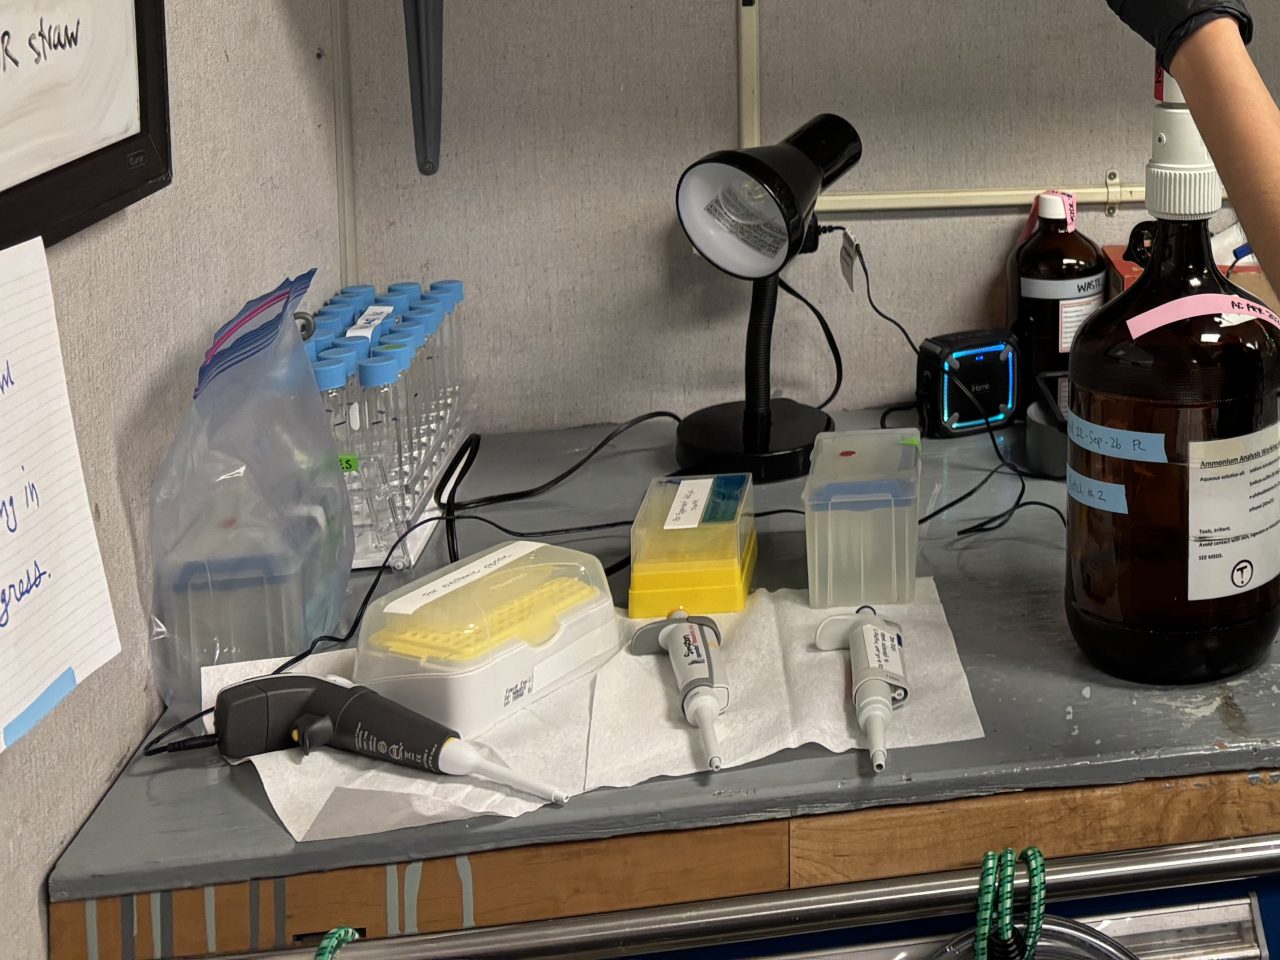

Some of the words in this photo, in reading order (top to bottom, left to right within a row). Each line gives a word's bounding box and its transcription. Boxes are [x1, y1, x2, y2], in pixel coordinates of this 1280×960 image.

[28, 16, 80, 64] straw
[1200, 456, 1239, 469] Ammonium
[1239, 451, 1261, 462] Analysis
[1261, 443, 1278, 456] Working
[1221, 472, 1239, 480] solution
